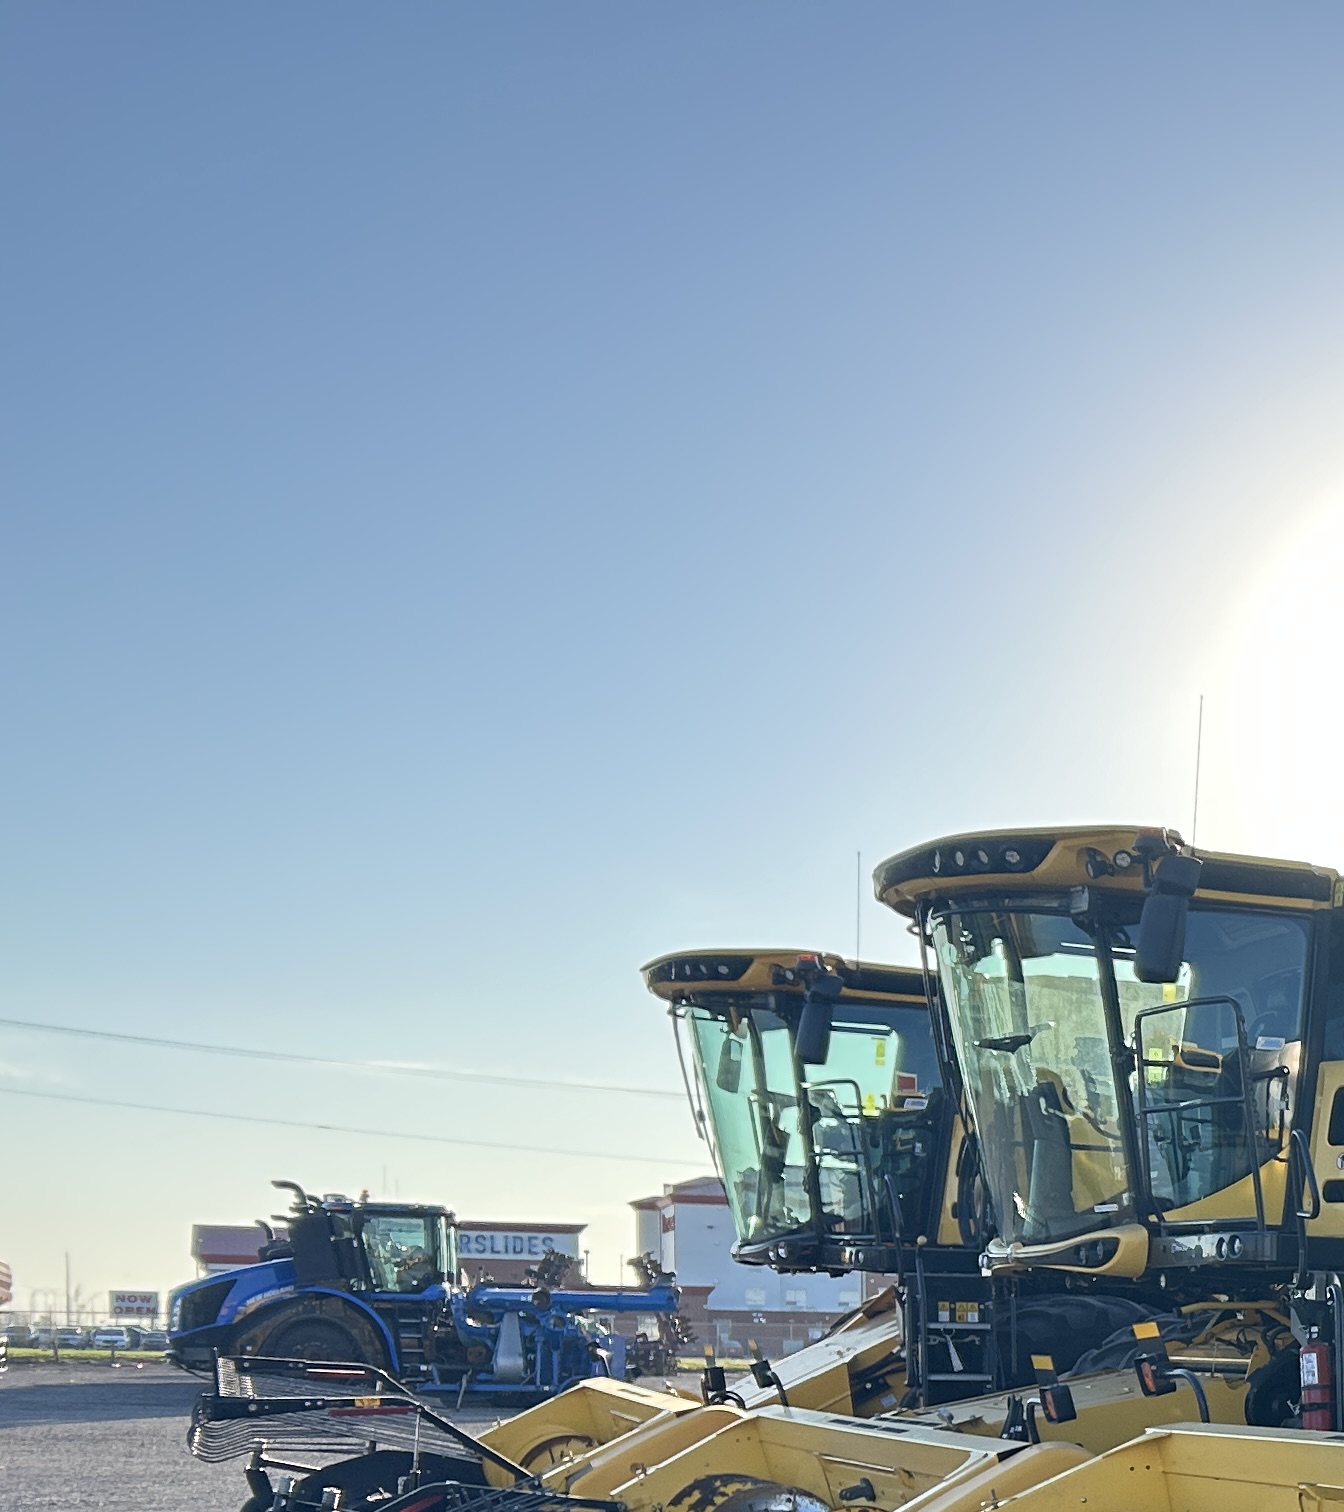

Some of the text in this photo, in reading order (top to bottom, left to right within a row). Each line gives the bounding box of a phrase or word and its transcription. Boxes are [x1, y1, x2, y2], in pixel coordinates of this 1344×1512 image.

[459, 1234, 554, 1255] RSLIDES
[115, 1294, 152, 1303] NOW
[113, 1306, 157, 1315] OPEN
